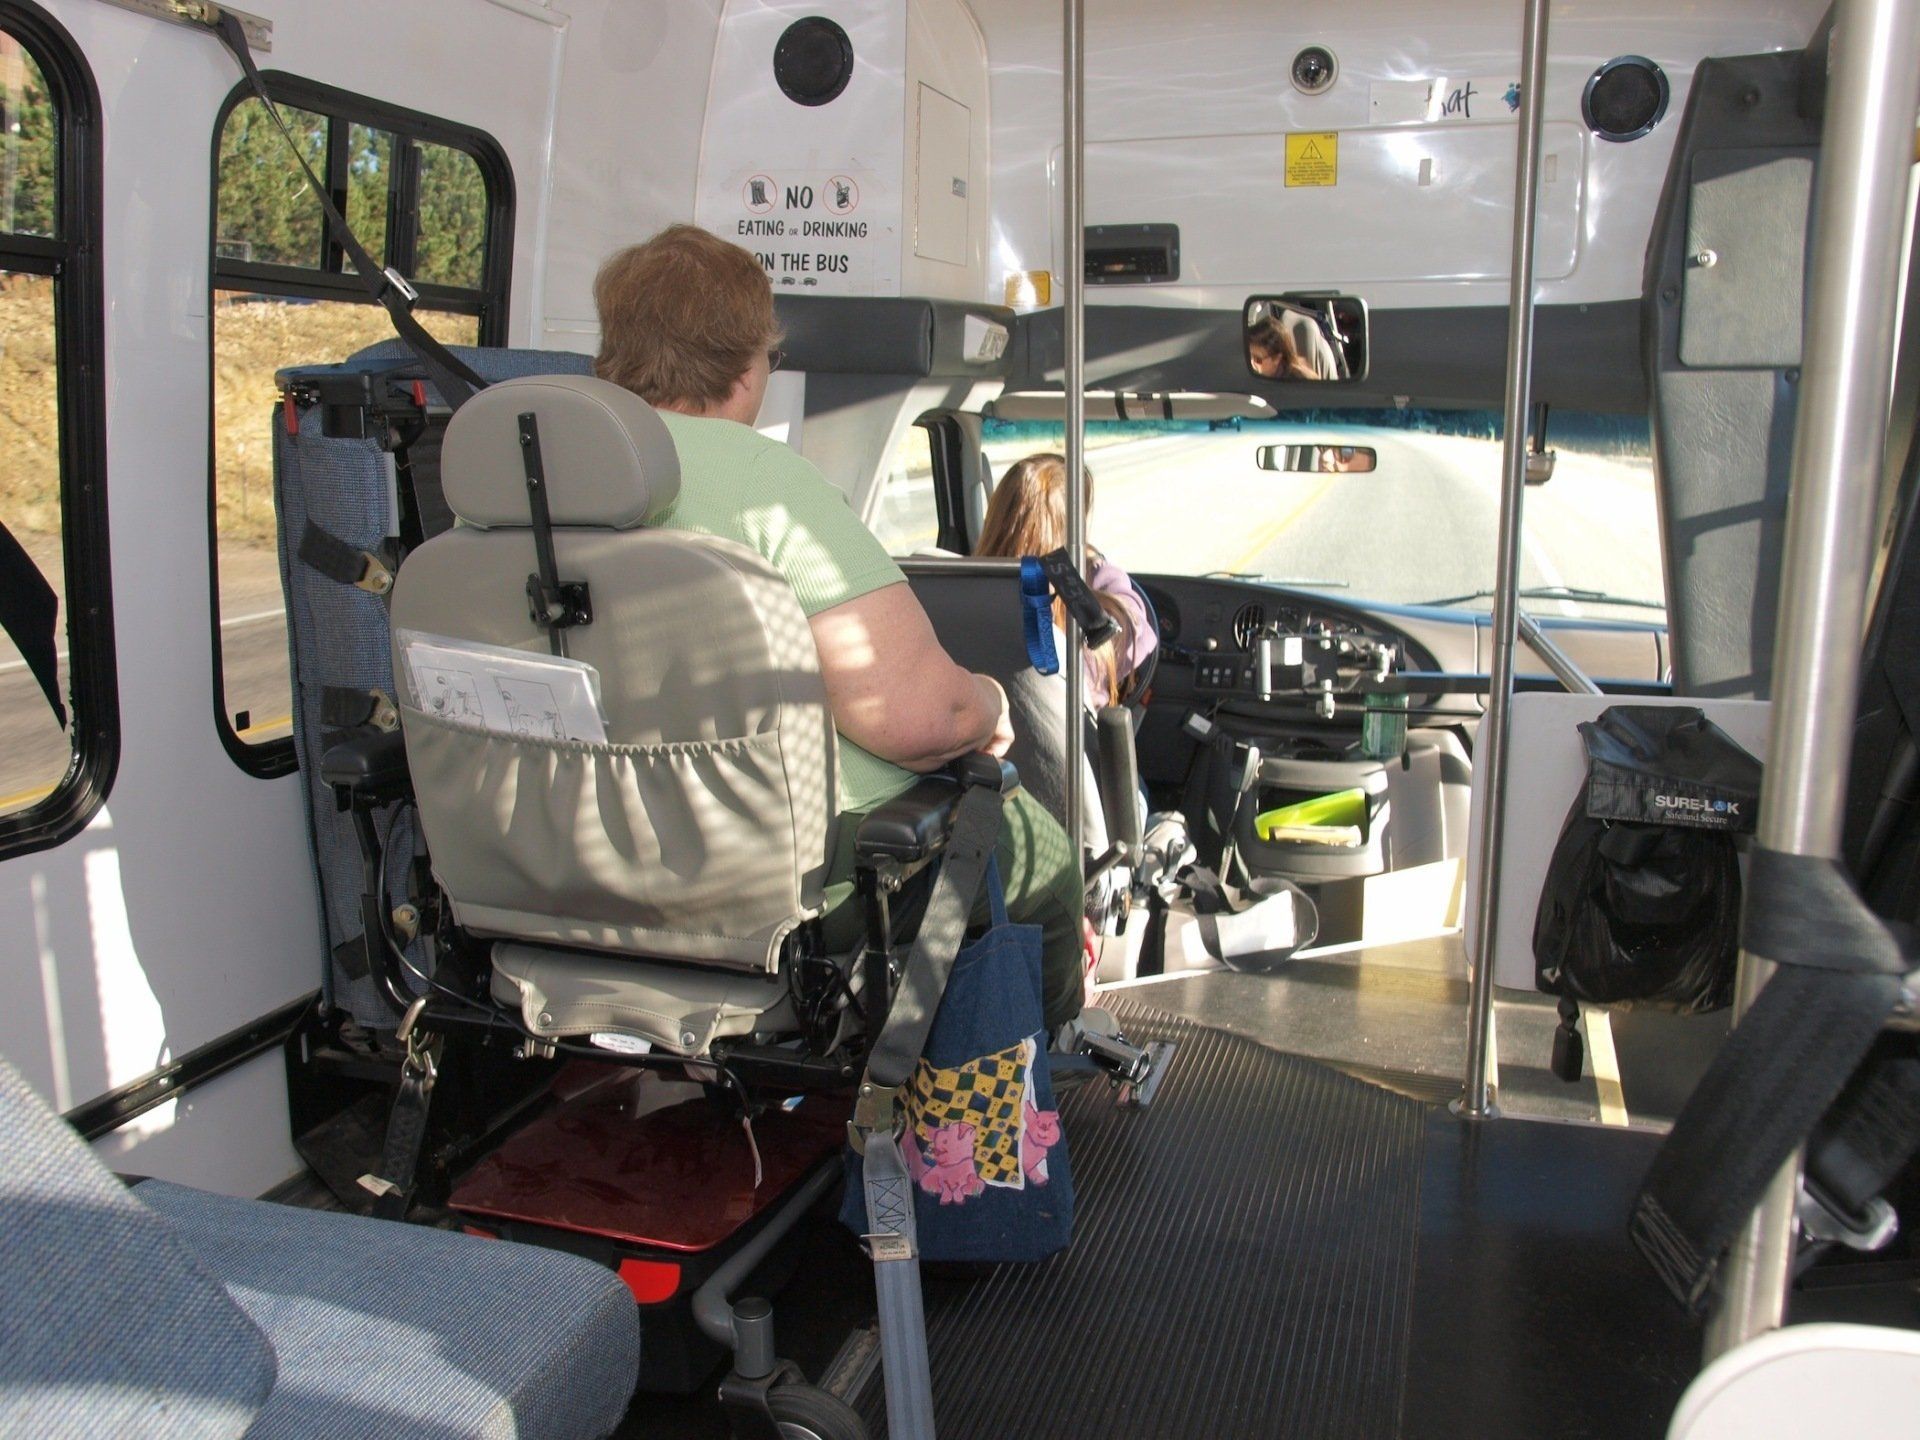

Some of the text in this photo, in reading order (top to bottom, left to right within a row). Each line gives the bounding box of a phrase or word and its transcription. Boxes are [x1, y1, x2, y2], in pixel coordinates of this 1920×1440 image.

[786, 185, 814, 210] NO
[737, 219, 868, 239] EATING OR DRINKING
[781, 253, 810, 272] THE
[816, 253, 849, 274] BUS
[1665, 809, 1682, 820] Safe
[1700, 813, 1728, 825] Secure
